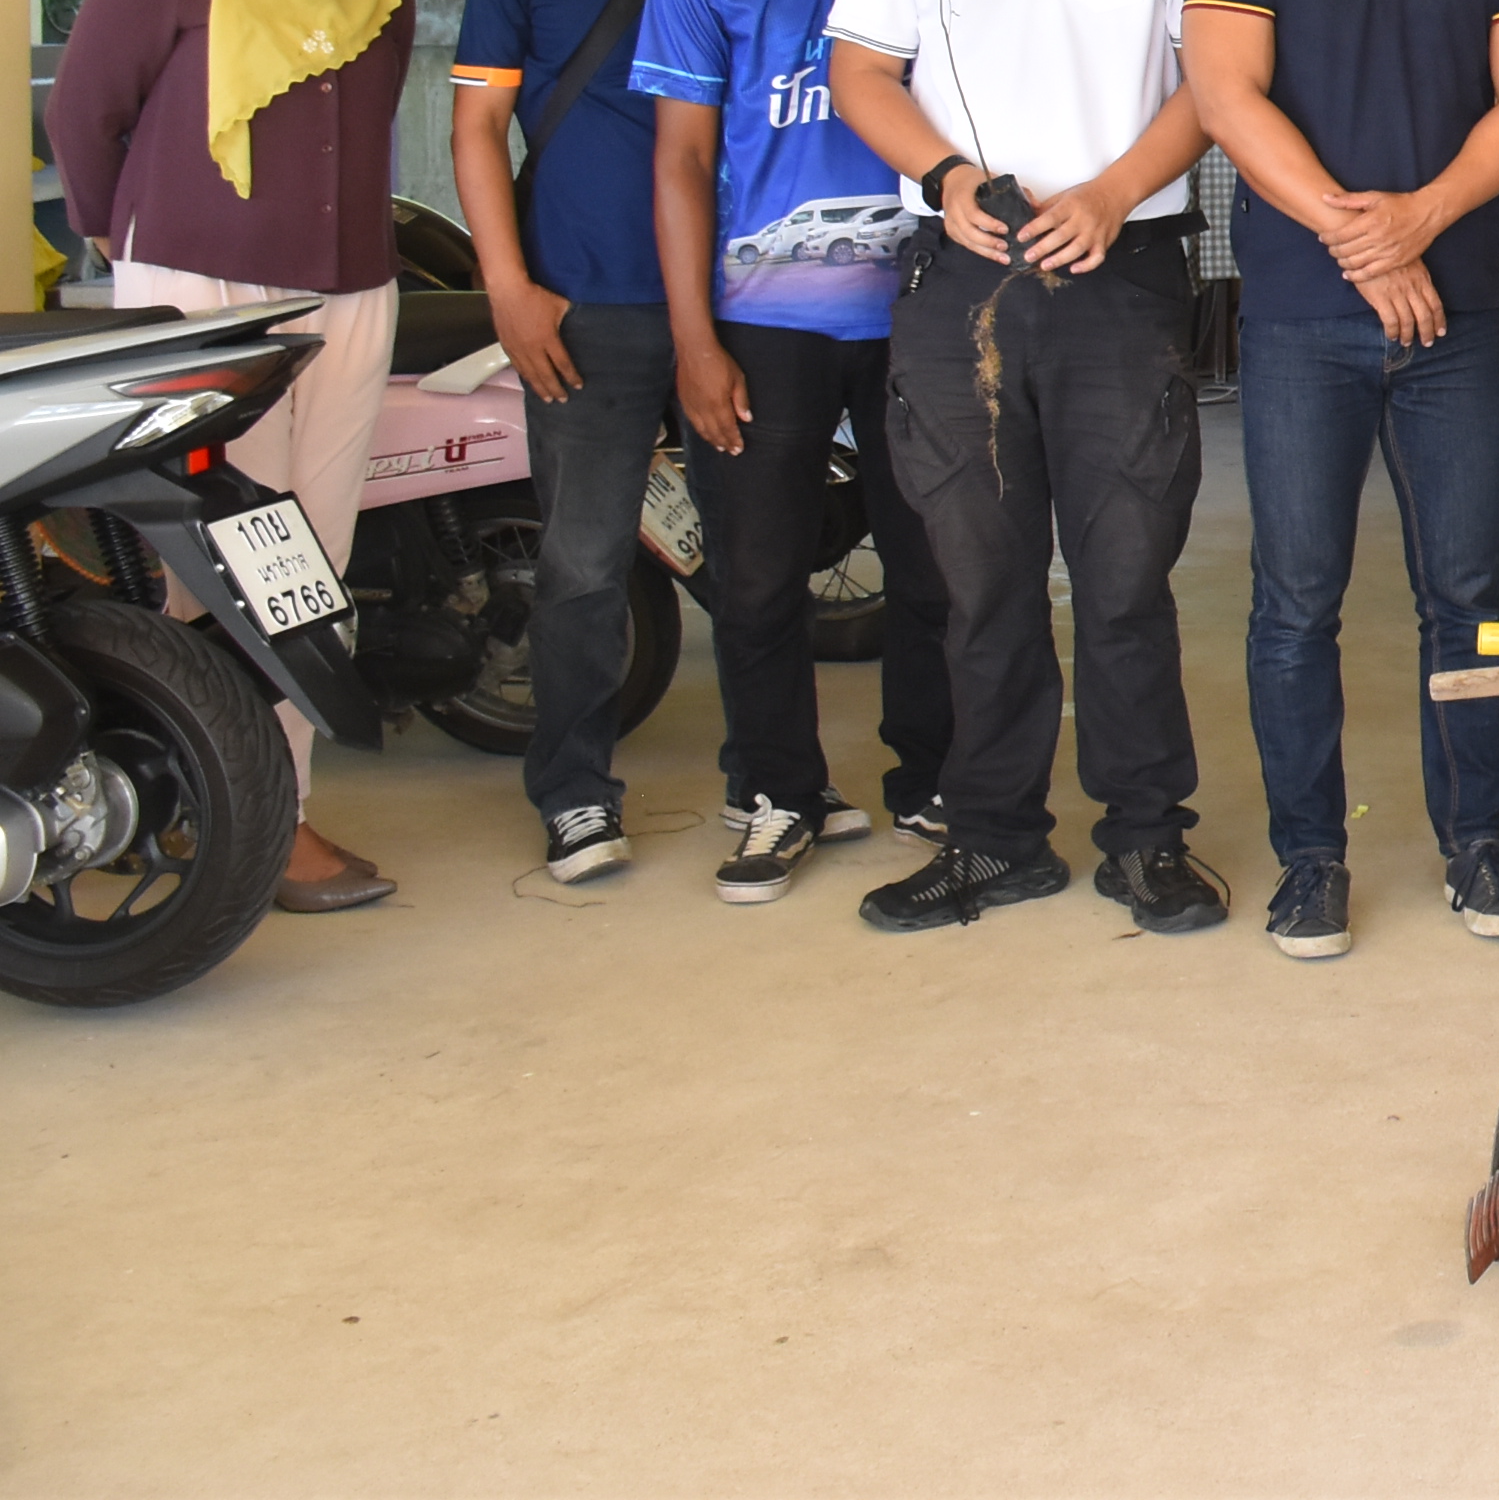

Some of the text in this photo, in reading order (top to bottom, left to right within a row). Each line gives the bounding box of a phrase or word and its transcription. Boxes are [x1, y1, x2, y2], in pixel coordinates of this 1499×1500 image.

[236, 509, 291, 551] 1กย
[257, 553, 310, 583] นราธิวาส
[267, 580, 335, 626] 6766
